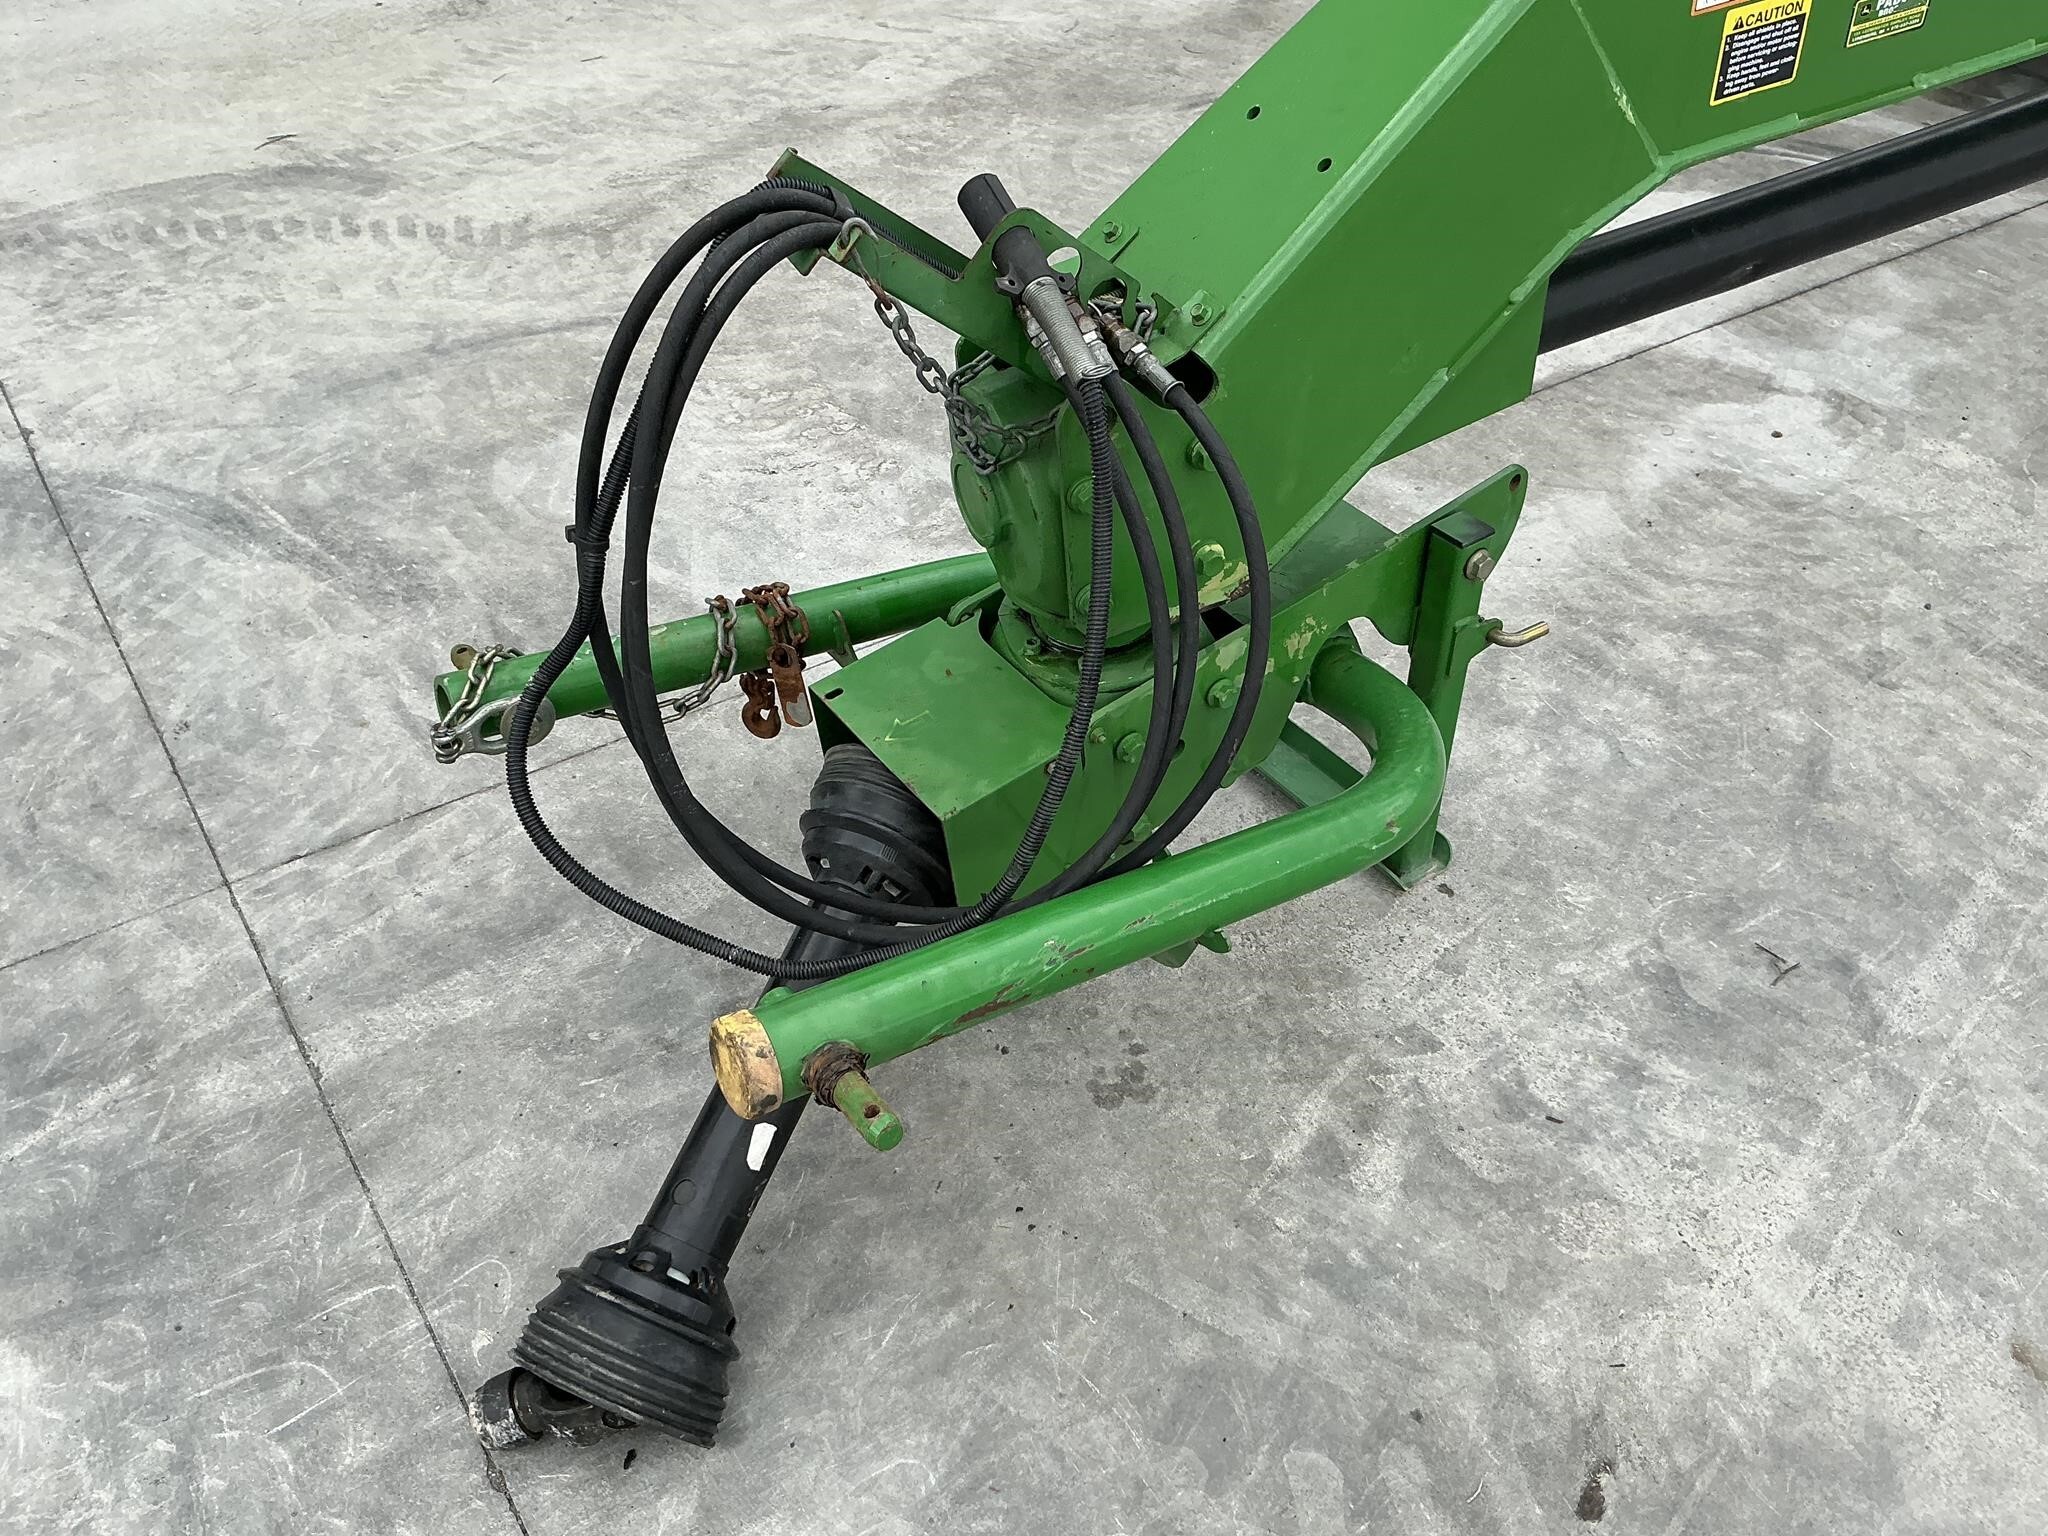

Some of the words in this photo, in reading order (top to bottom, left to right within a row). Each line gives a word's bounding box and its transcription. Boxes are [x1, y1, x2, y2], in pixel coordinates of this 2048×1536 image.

[1745, 0, 1804, 27] CAUTION
[1756, 25, 1775, 35] shields
[1761, 32, 1772, 40] and
[1726, 72, 1740, 80] Keep
